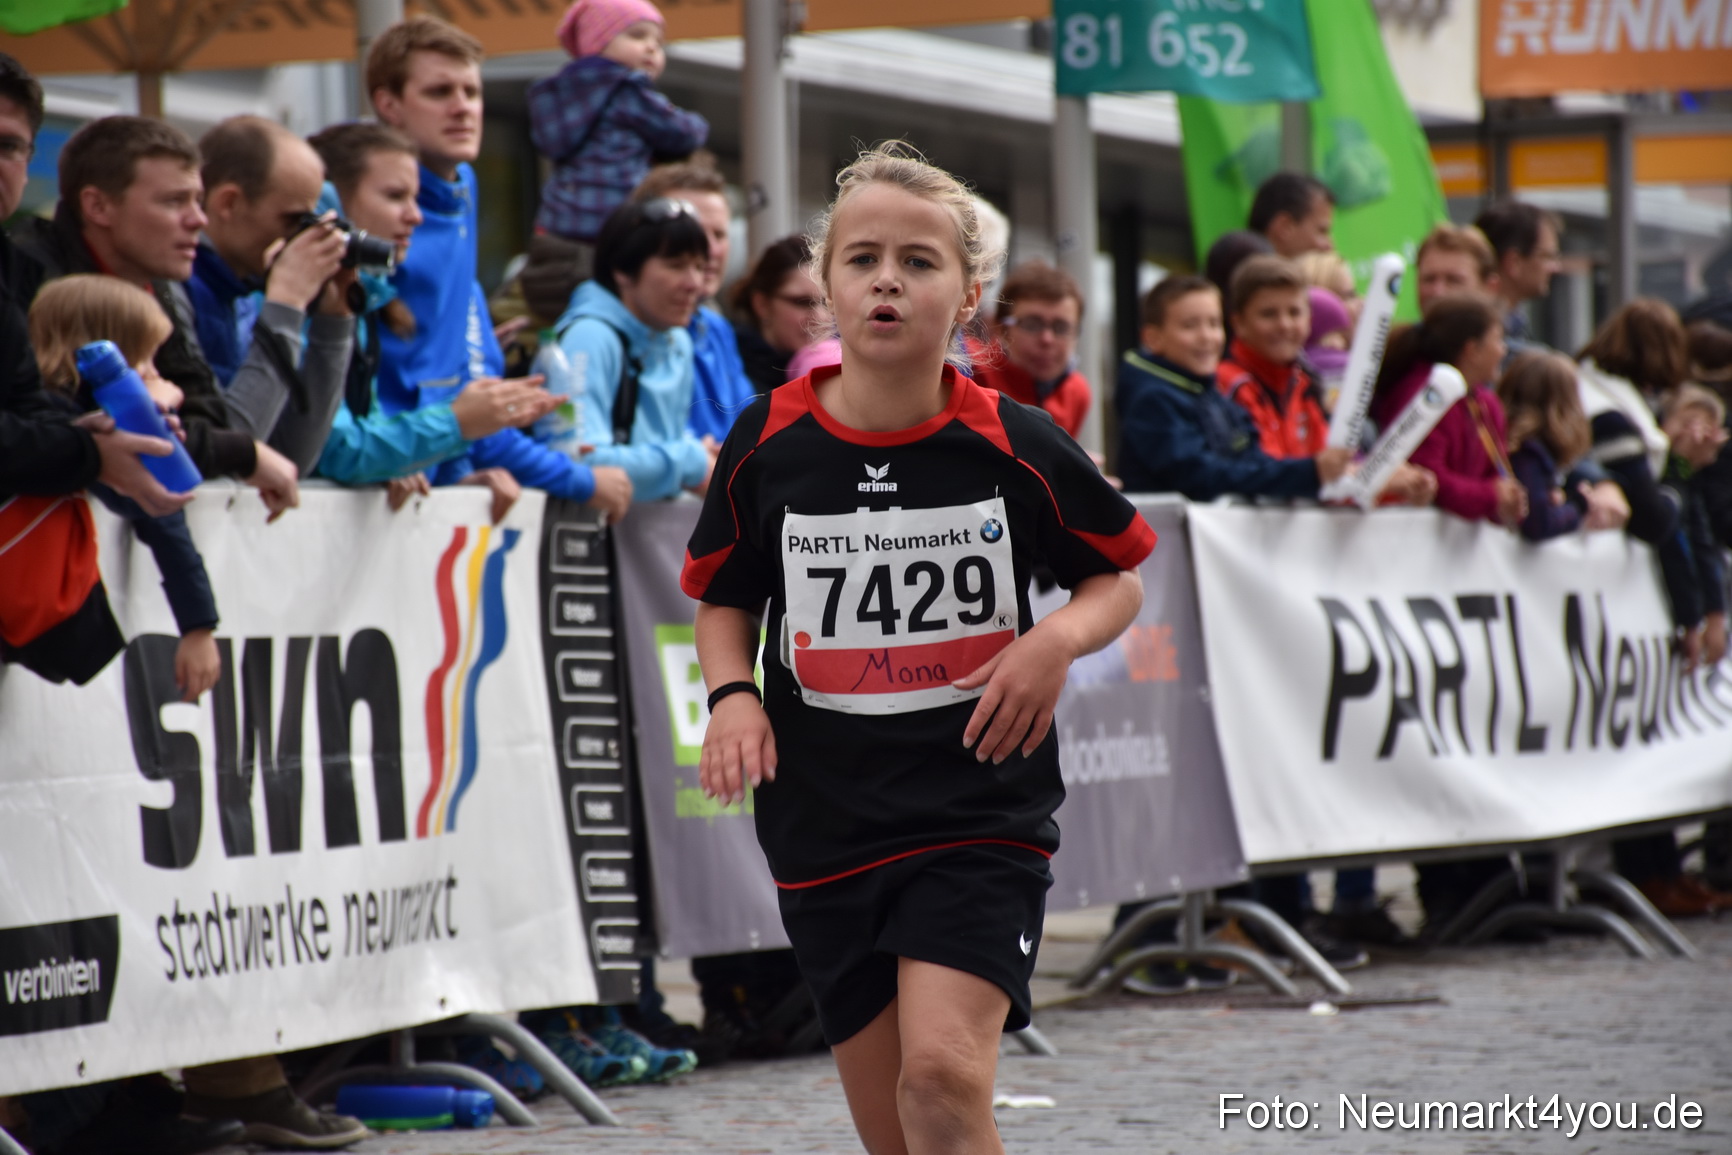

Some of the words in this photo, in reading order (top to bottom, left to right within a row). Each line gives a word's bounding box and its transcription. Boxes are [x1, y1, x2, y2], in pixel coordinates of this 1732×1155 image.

[1061, 13, 1122, 70] 81
[1148, 10, 1254, 77] 652
[857, 480, 898, 492] erima
[788, 535, 859, 554] PARTL
[865, 529, 972, 551] Neumarkt
[806, 555, 997, 638] 7429
[998, 615, 1007, 627] K
[851, 648, 949, 692] Mona
[1317, 593, 1549, 762] PARTL
[123, 627, 408, 870] swn
[156, 883, 331, 982] stadtwerke
[4, 956, 101, 1004] verbinden
